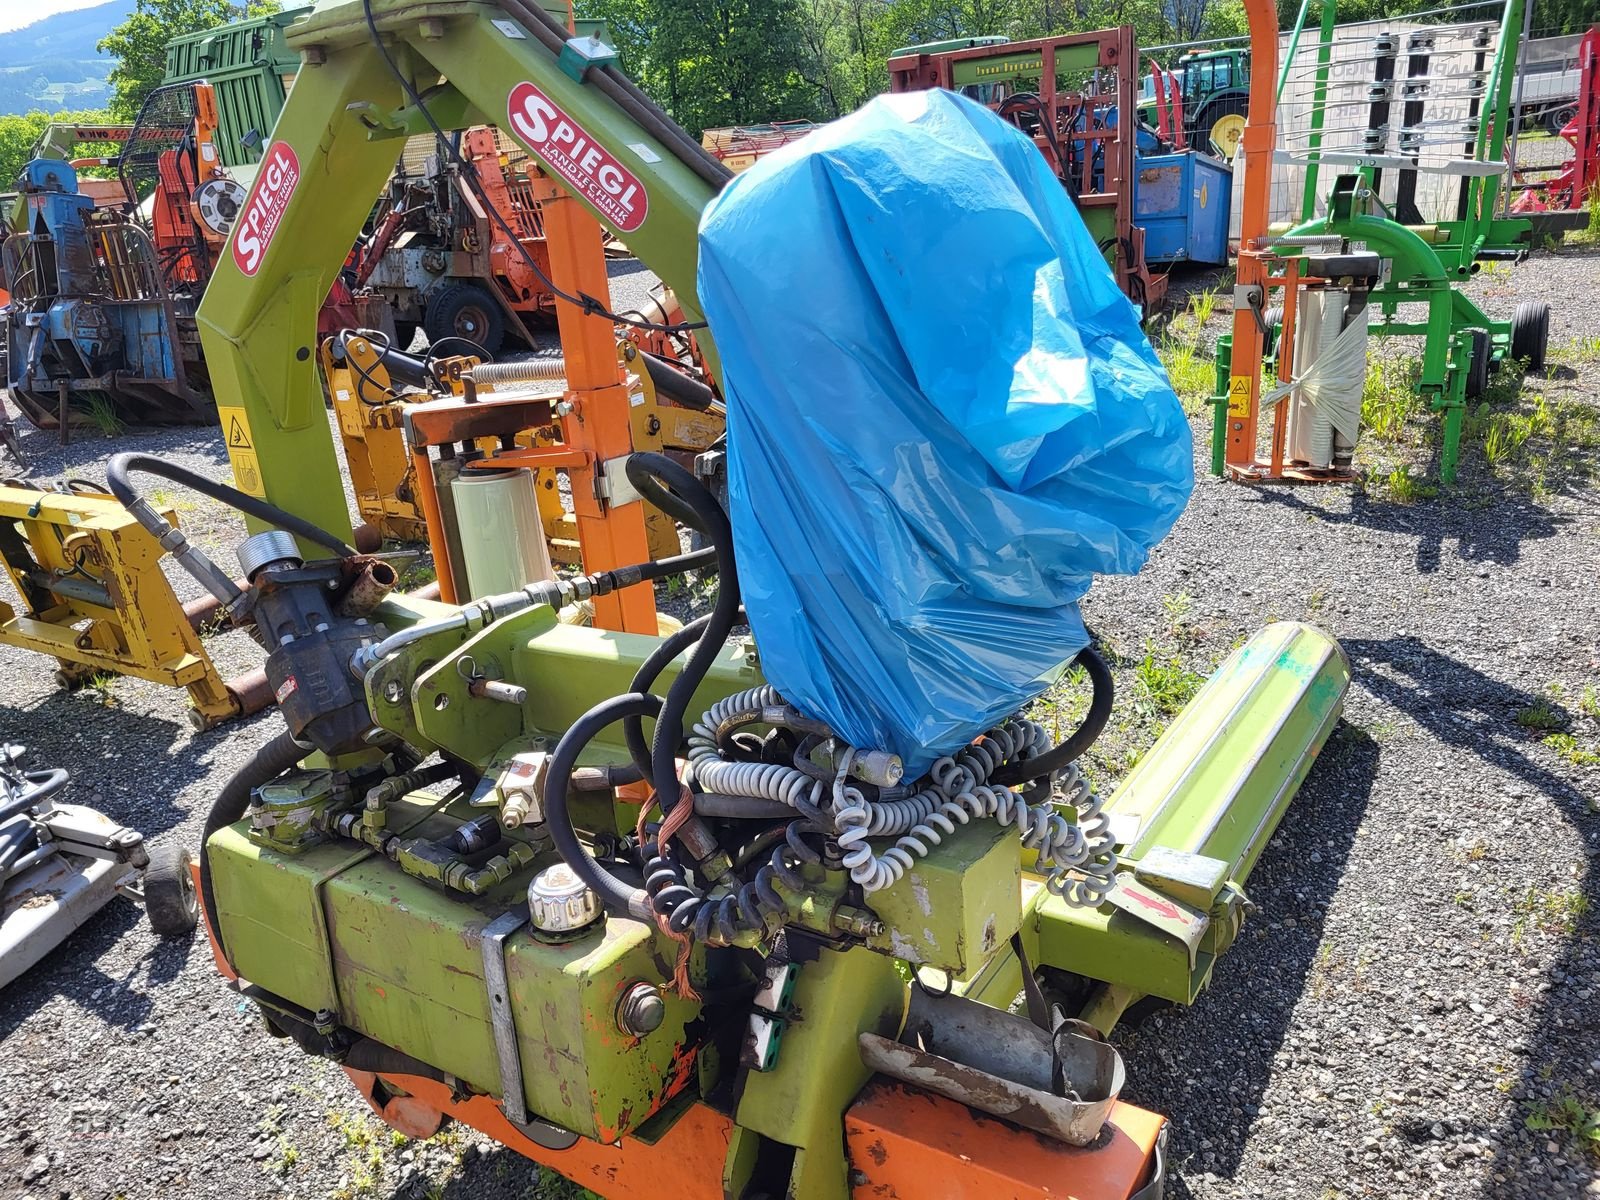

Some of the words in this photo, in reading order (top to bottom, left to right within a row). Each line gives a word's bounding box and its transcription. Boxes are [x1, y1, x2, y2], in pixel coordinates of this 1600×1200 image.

[512, 95, 638, 213] SPIEGL
[544, 142, 629, 222] LANDTECHNIK
[237, 151, 290, 272] SPIEGL
[259, 167, 296, 244] LANDTECHNIK
